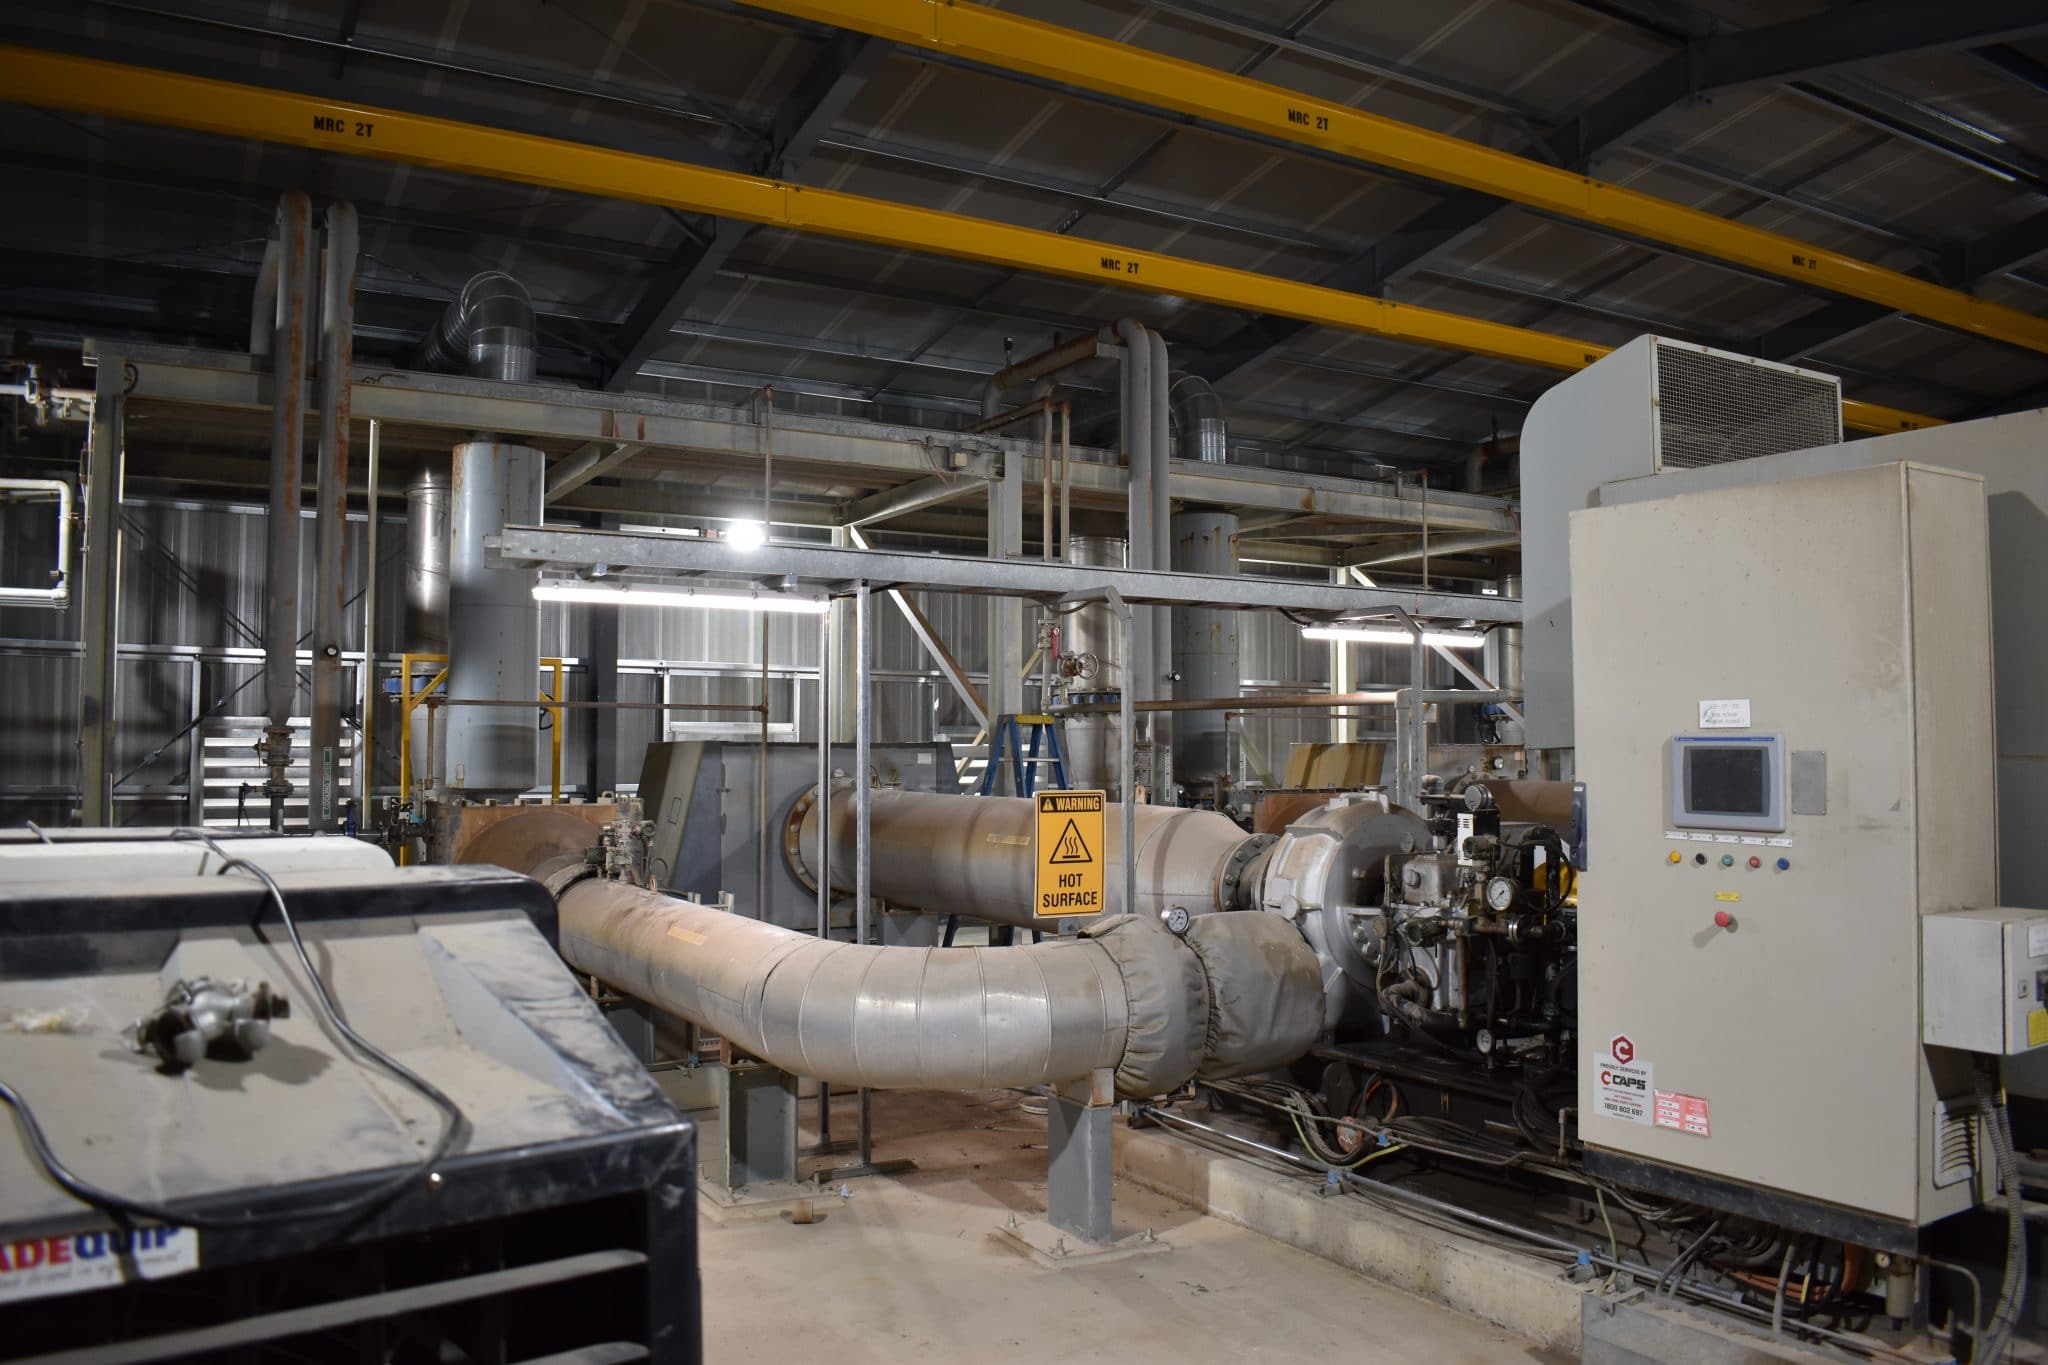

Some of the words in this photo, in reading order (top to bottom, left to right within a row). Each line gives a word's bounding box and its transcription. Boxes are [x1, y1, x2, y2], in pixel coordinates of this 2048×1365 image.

[313, 115, 345, 133] MRC
[355, 121, 374, 138] 2T
[1288, 108, 1310, 126] MRC
[1316, 115, 1329, 131] 2T
[1100, 256, 1121, 271] MRC
[1127, 261, 1139, 274] 2T
[1055, 796, 1100, 811] WARNING
[1058, 873, 1083, 888] HOT
[1042, 891, 1098, 908] SURFACE
[1612, 1074, 1646, 1090] CAPS
